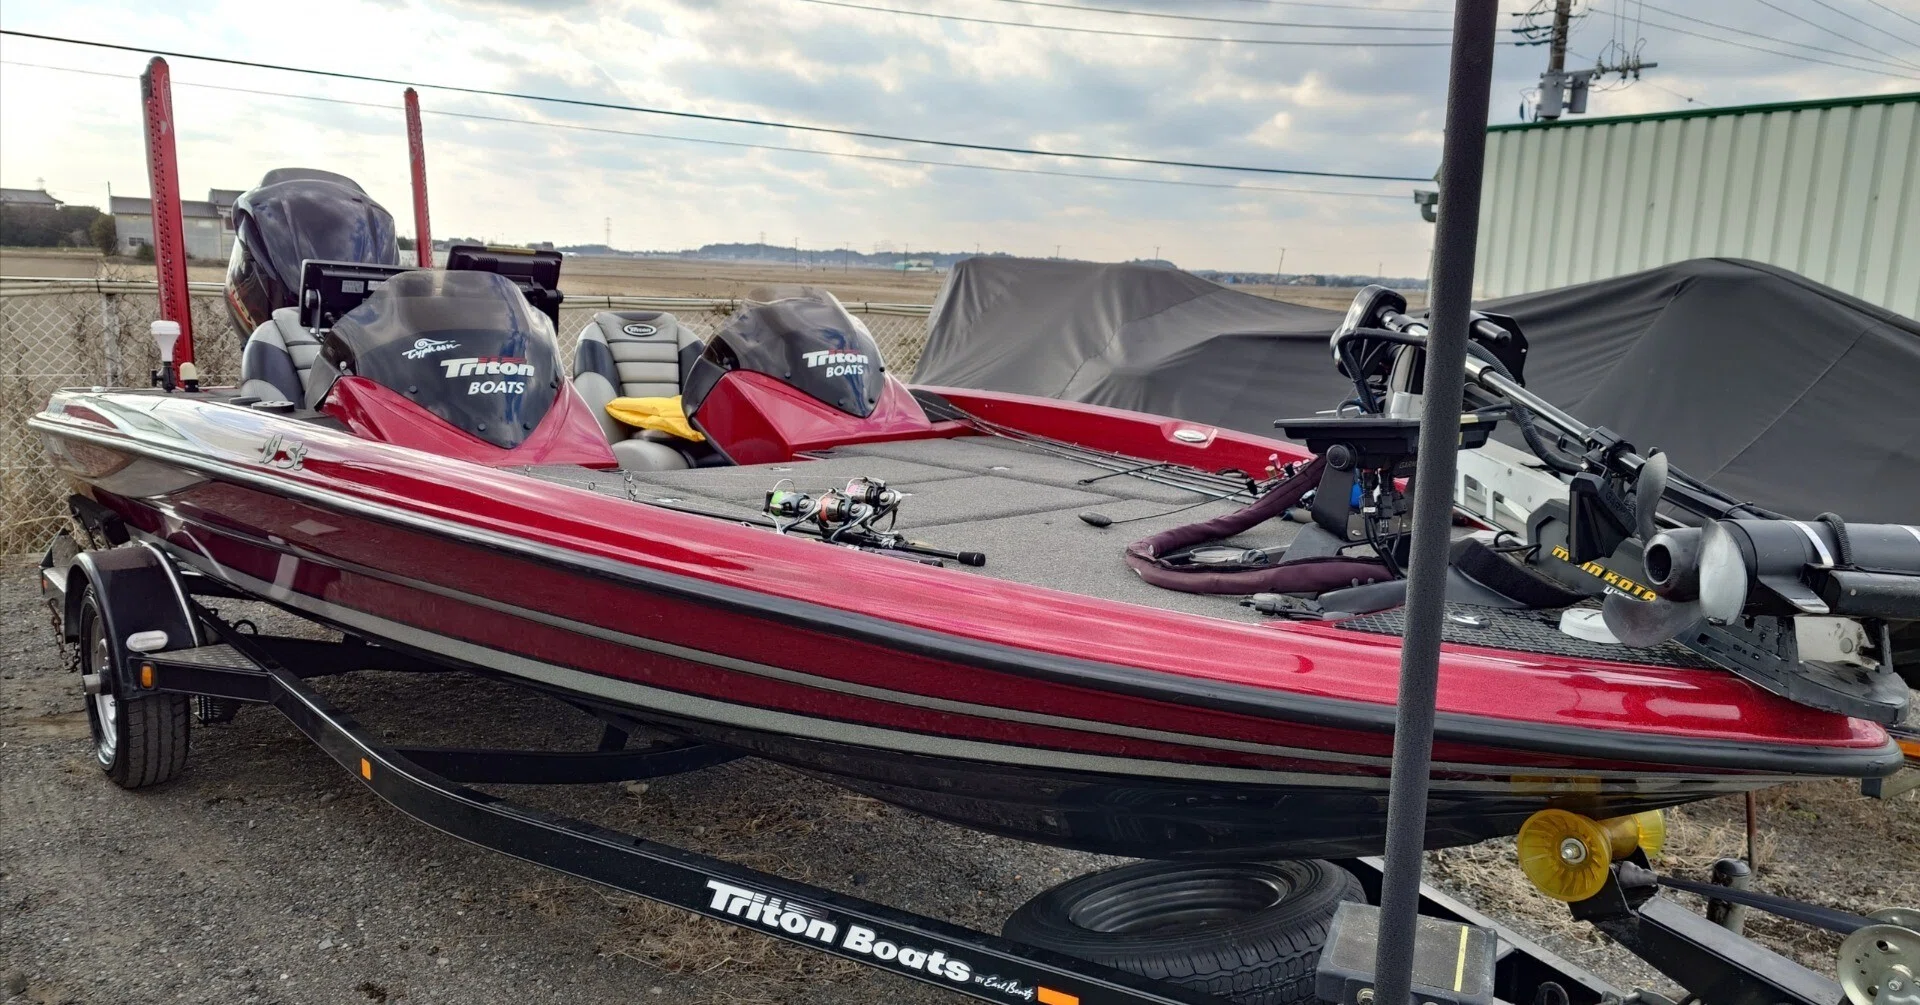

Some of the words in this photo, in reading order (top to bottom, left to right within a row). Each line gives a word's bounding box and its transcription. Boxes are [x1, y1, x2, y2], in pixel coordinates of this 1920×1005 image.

[440, 357, 534, 378] Triton
[802, 349, 869, 368] Triton
[826, 365, 864, 378] BOATS
[468, 381, 525, 395] BOATS
[1603, 571, 1657, 602] KOTA
[706, 879, 837, 943] Triton
[842, 925, 970, 982] Boats
[974, 976, 985, 984] BY
